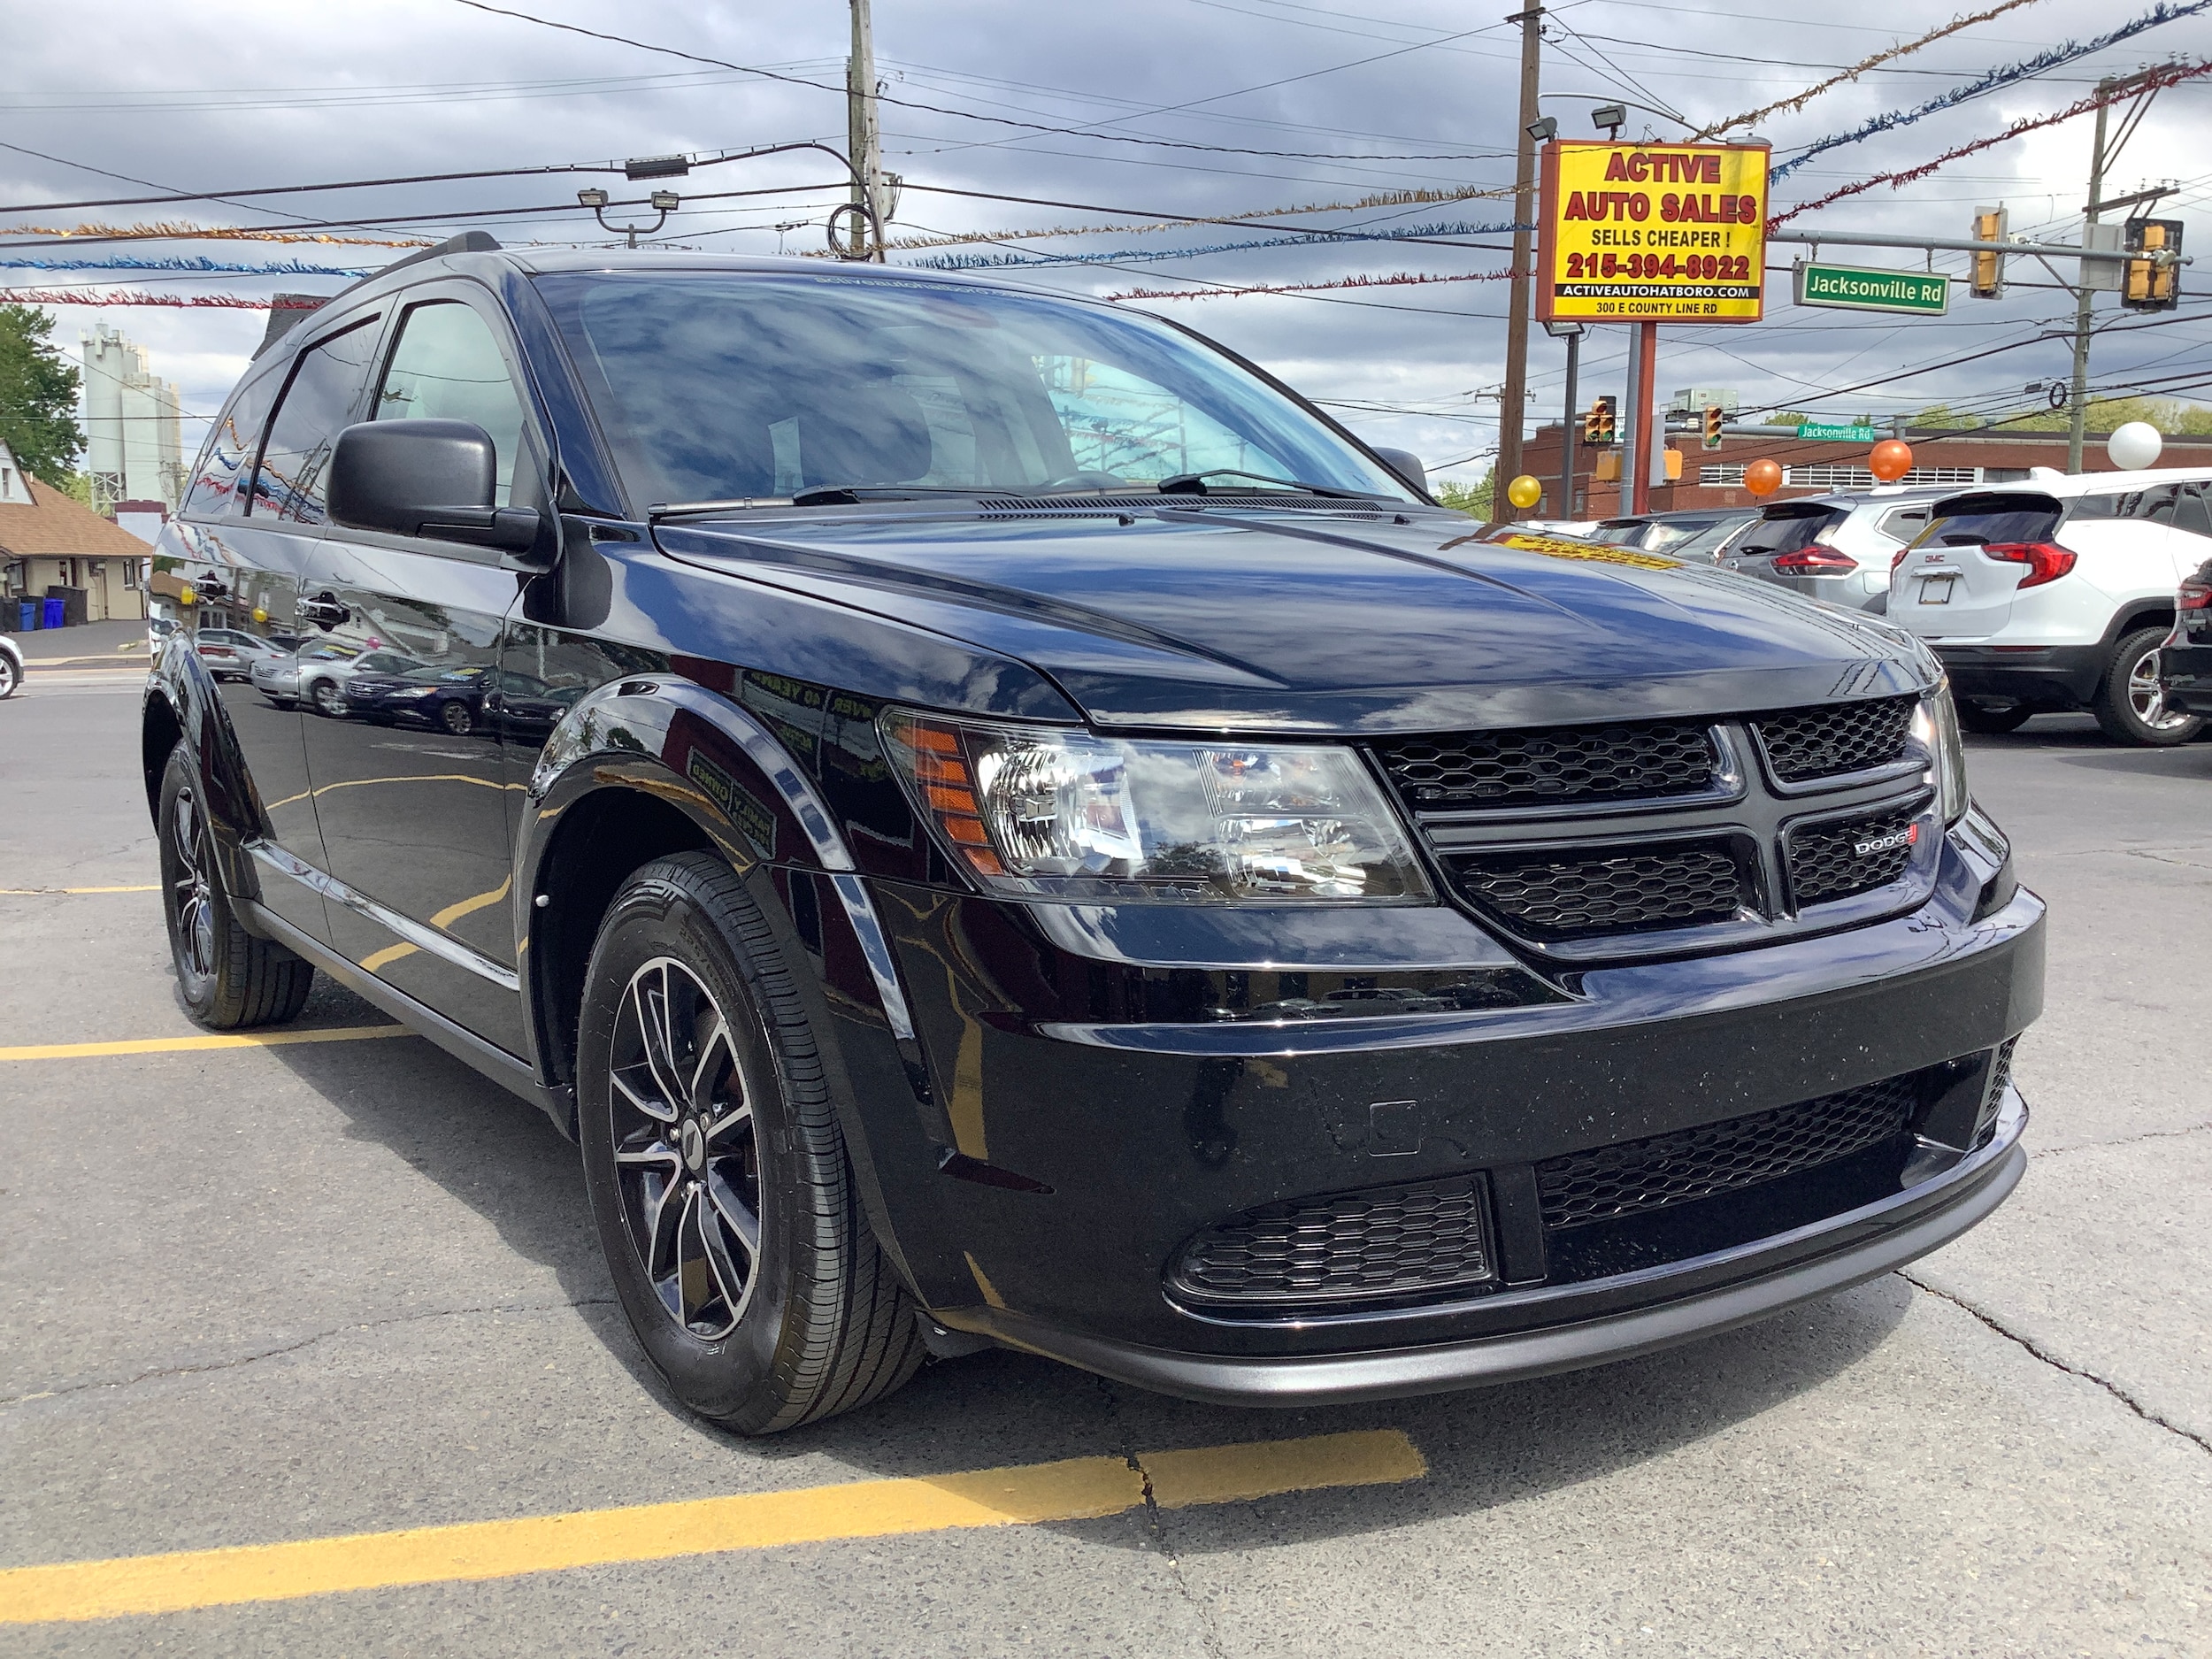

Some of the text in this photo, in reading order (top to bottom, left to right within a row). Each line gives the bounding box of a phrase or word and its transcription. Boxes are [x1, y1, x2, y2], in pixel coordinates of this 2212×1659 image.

[1604, 152, 1721, 184] ACTIVE
[1563, 191, 1757, 225] AUTO SALES
[1592, 229, 1641, 247] SELLS
[1647, 230, 1720, 248] CHEAPER
[1566, 253, 1750, 280] 215-394-8922
[1563, 285, 1750, 298] ACTIVEAUTOHATBORO.COM
[1809, 275, 1942, 303] Jacksonville Rd
[1596, 302, 1717, 314] 300 E COUNTY LINE RD
[1801, 424, 1870, 441] Jacksonville Rd
[1855, 831, 1911, 854] DODGE
